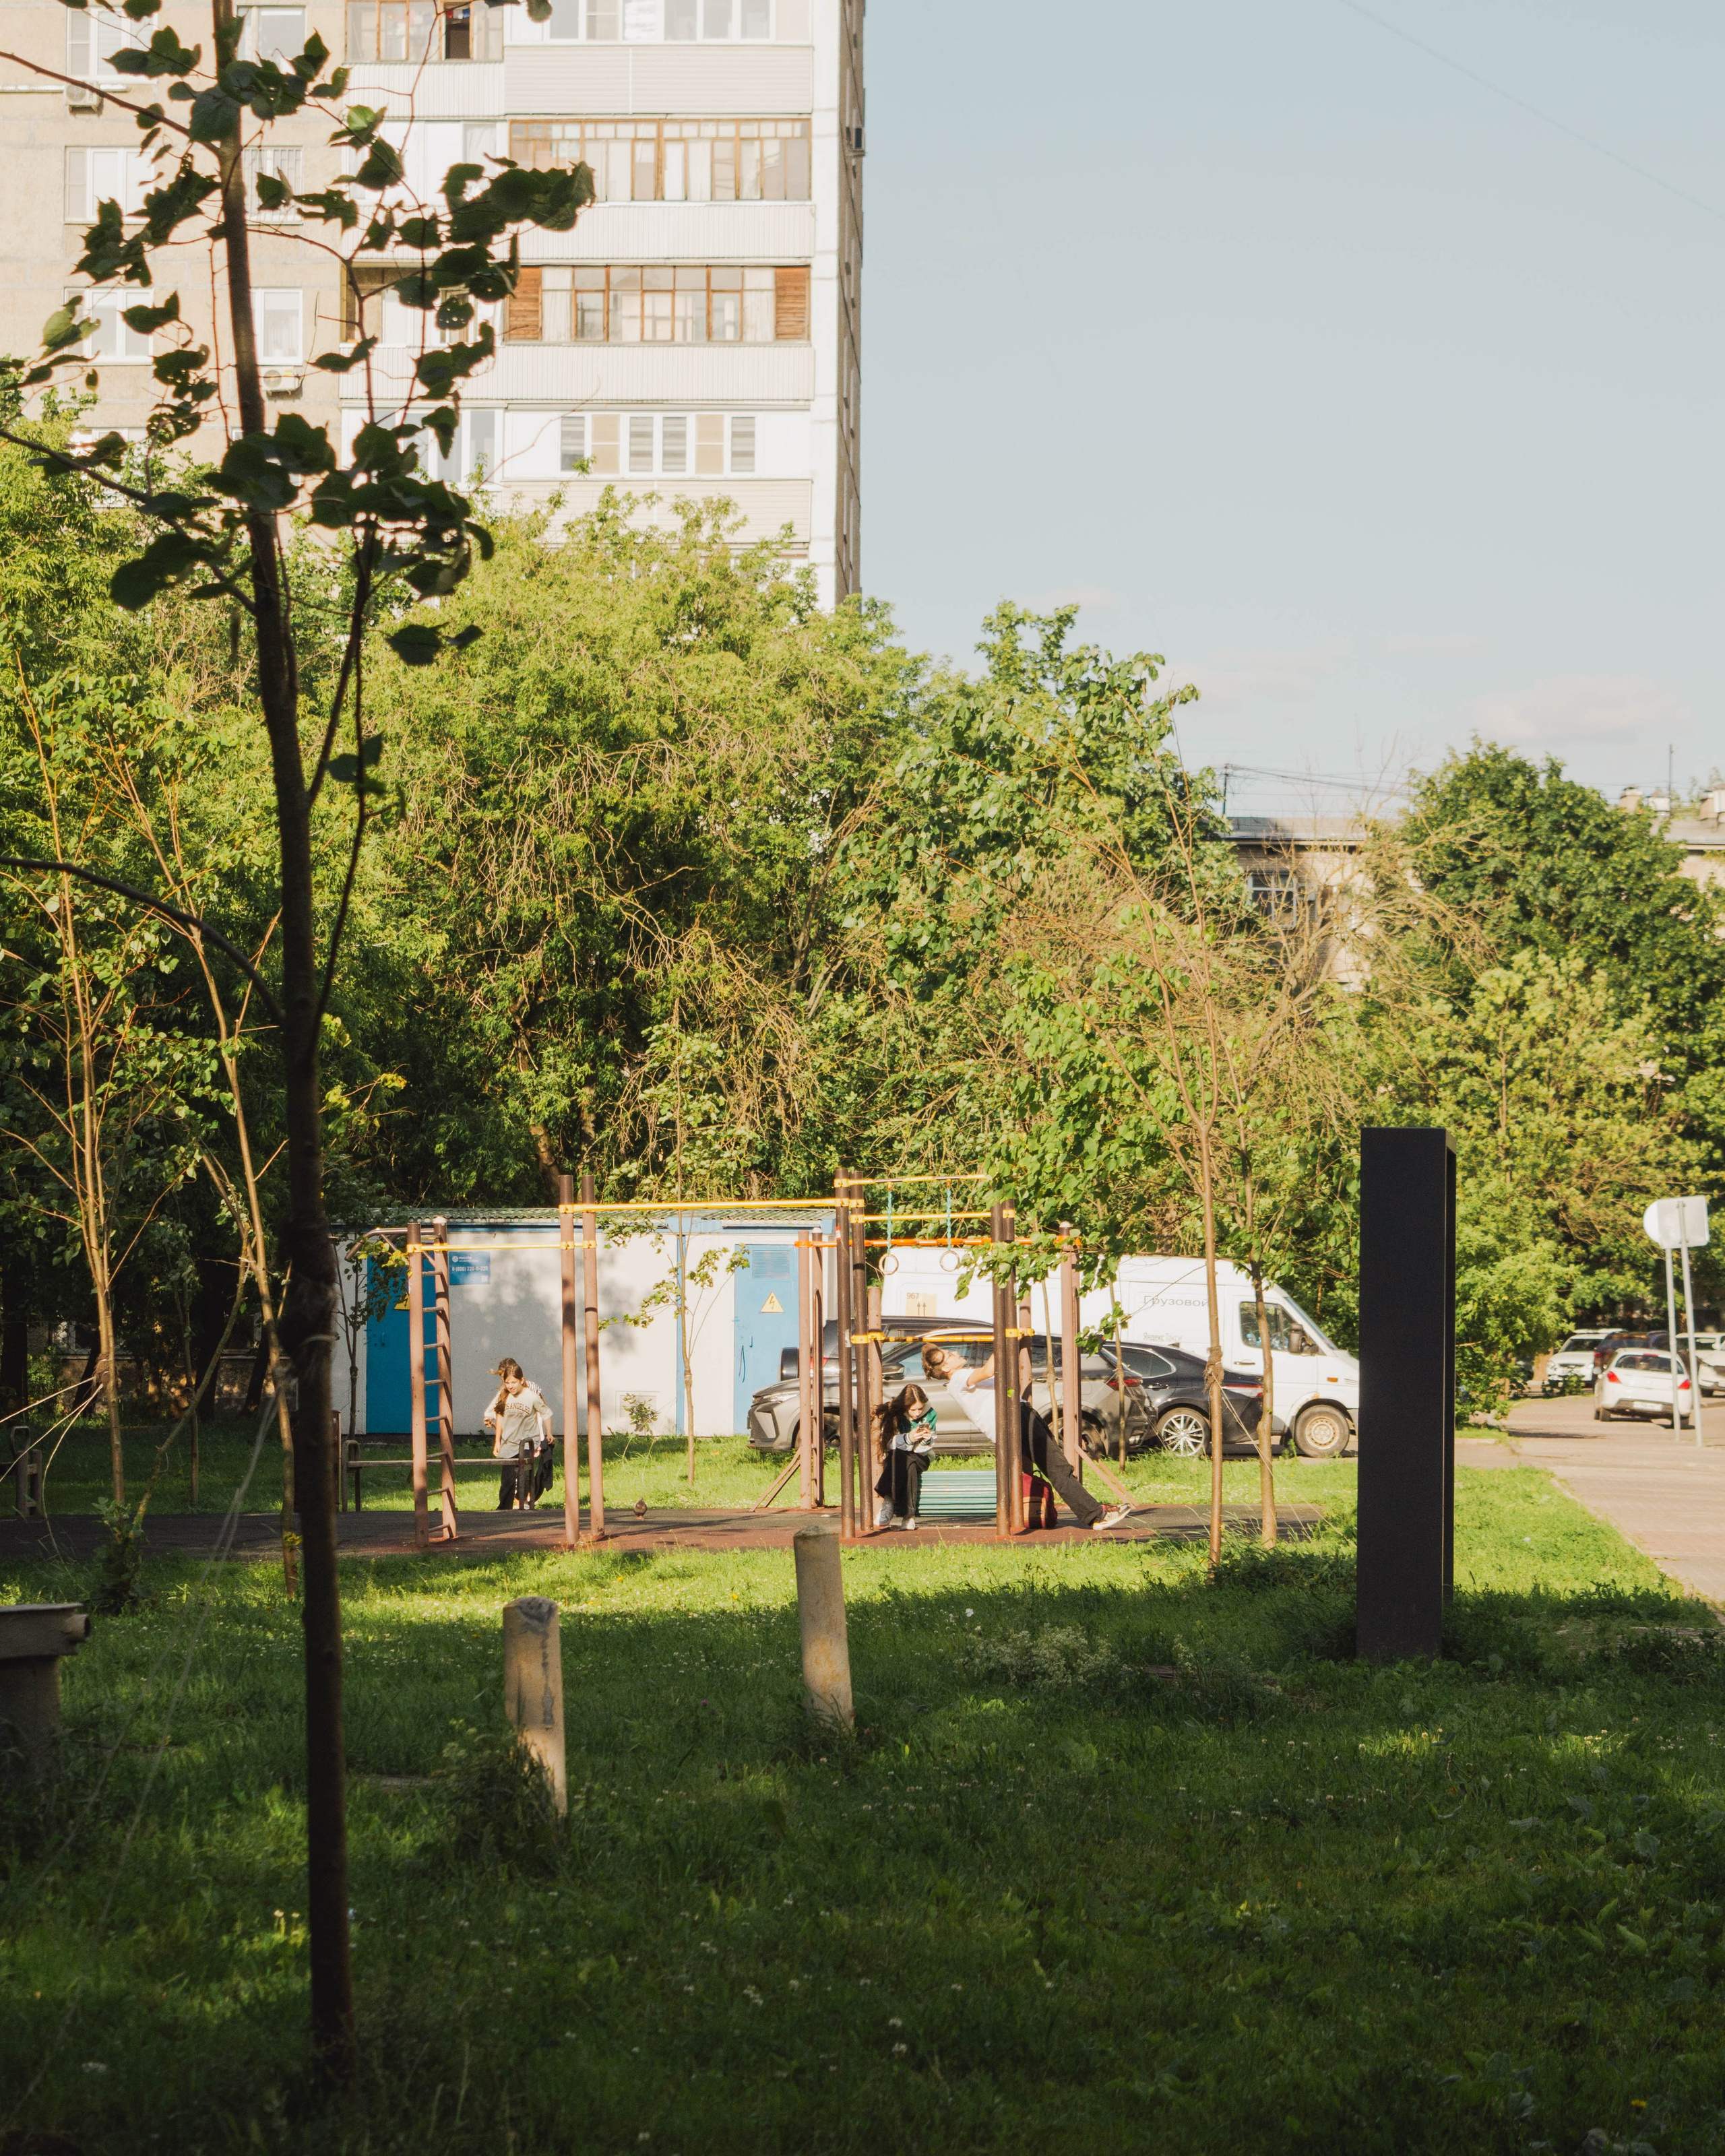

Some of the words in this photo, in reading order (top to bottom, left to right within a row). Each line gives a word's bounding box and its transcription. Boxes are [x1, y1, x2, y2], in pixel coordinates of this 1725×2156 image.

[1143, 1296, 1208, 1307] Грузовой
[1143, 1332, 1164, 1341] Яндекс
[509, 1402, 530, 1415] ANGELES
